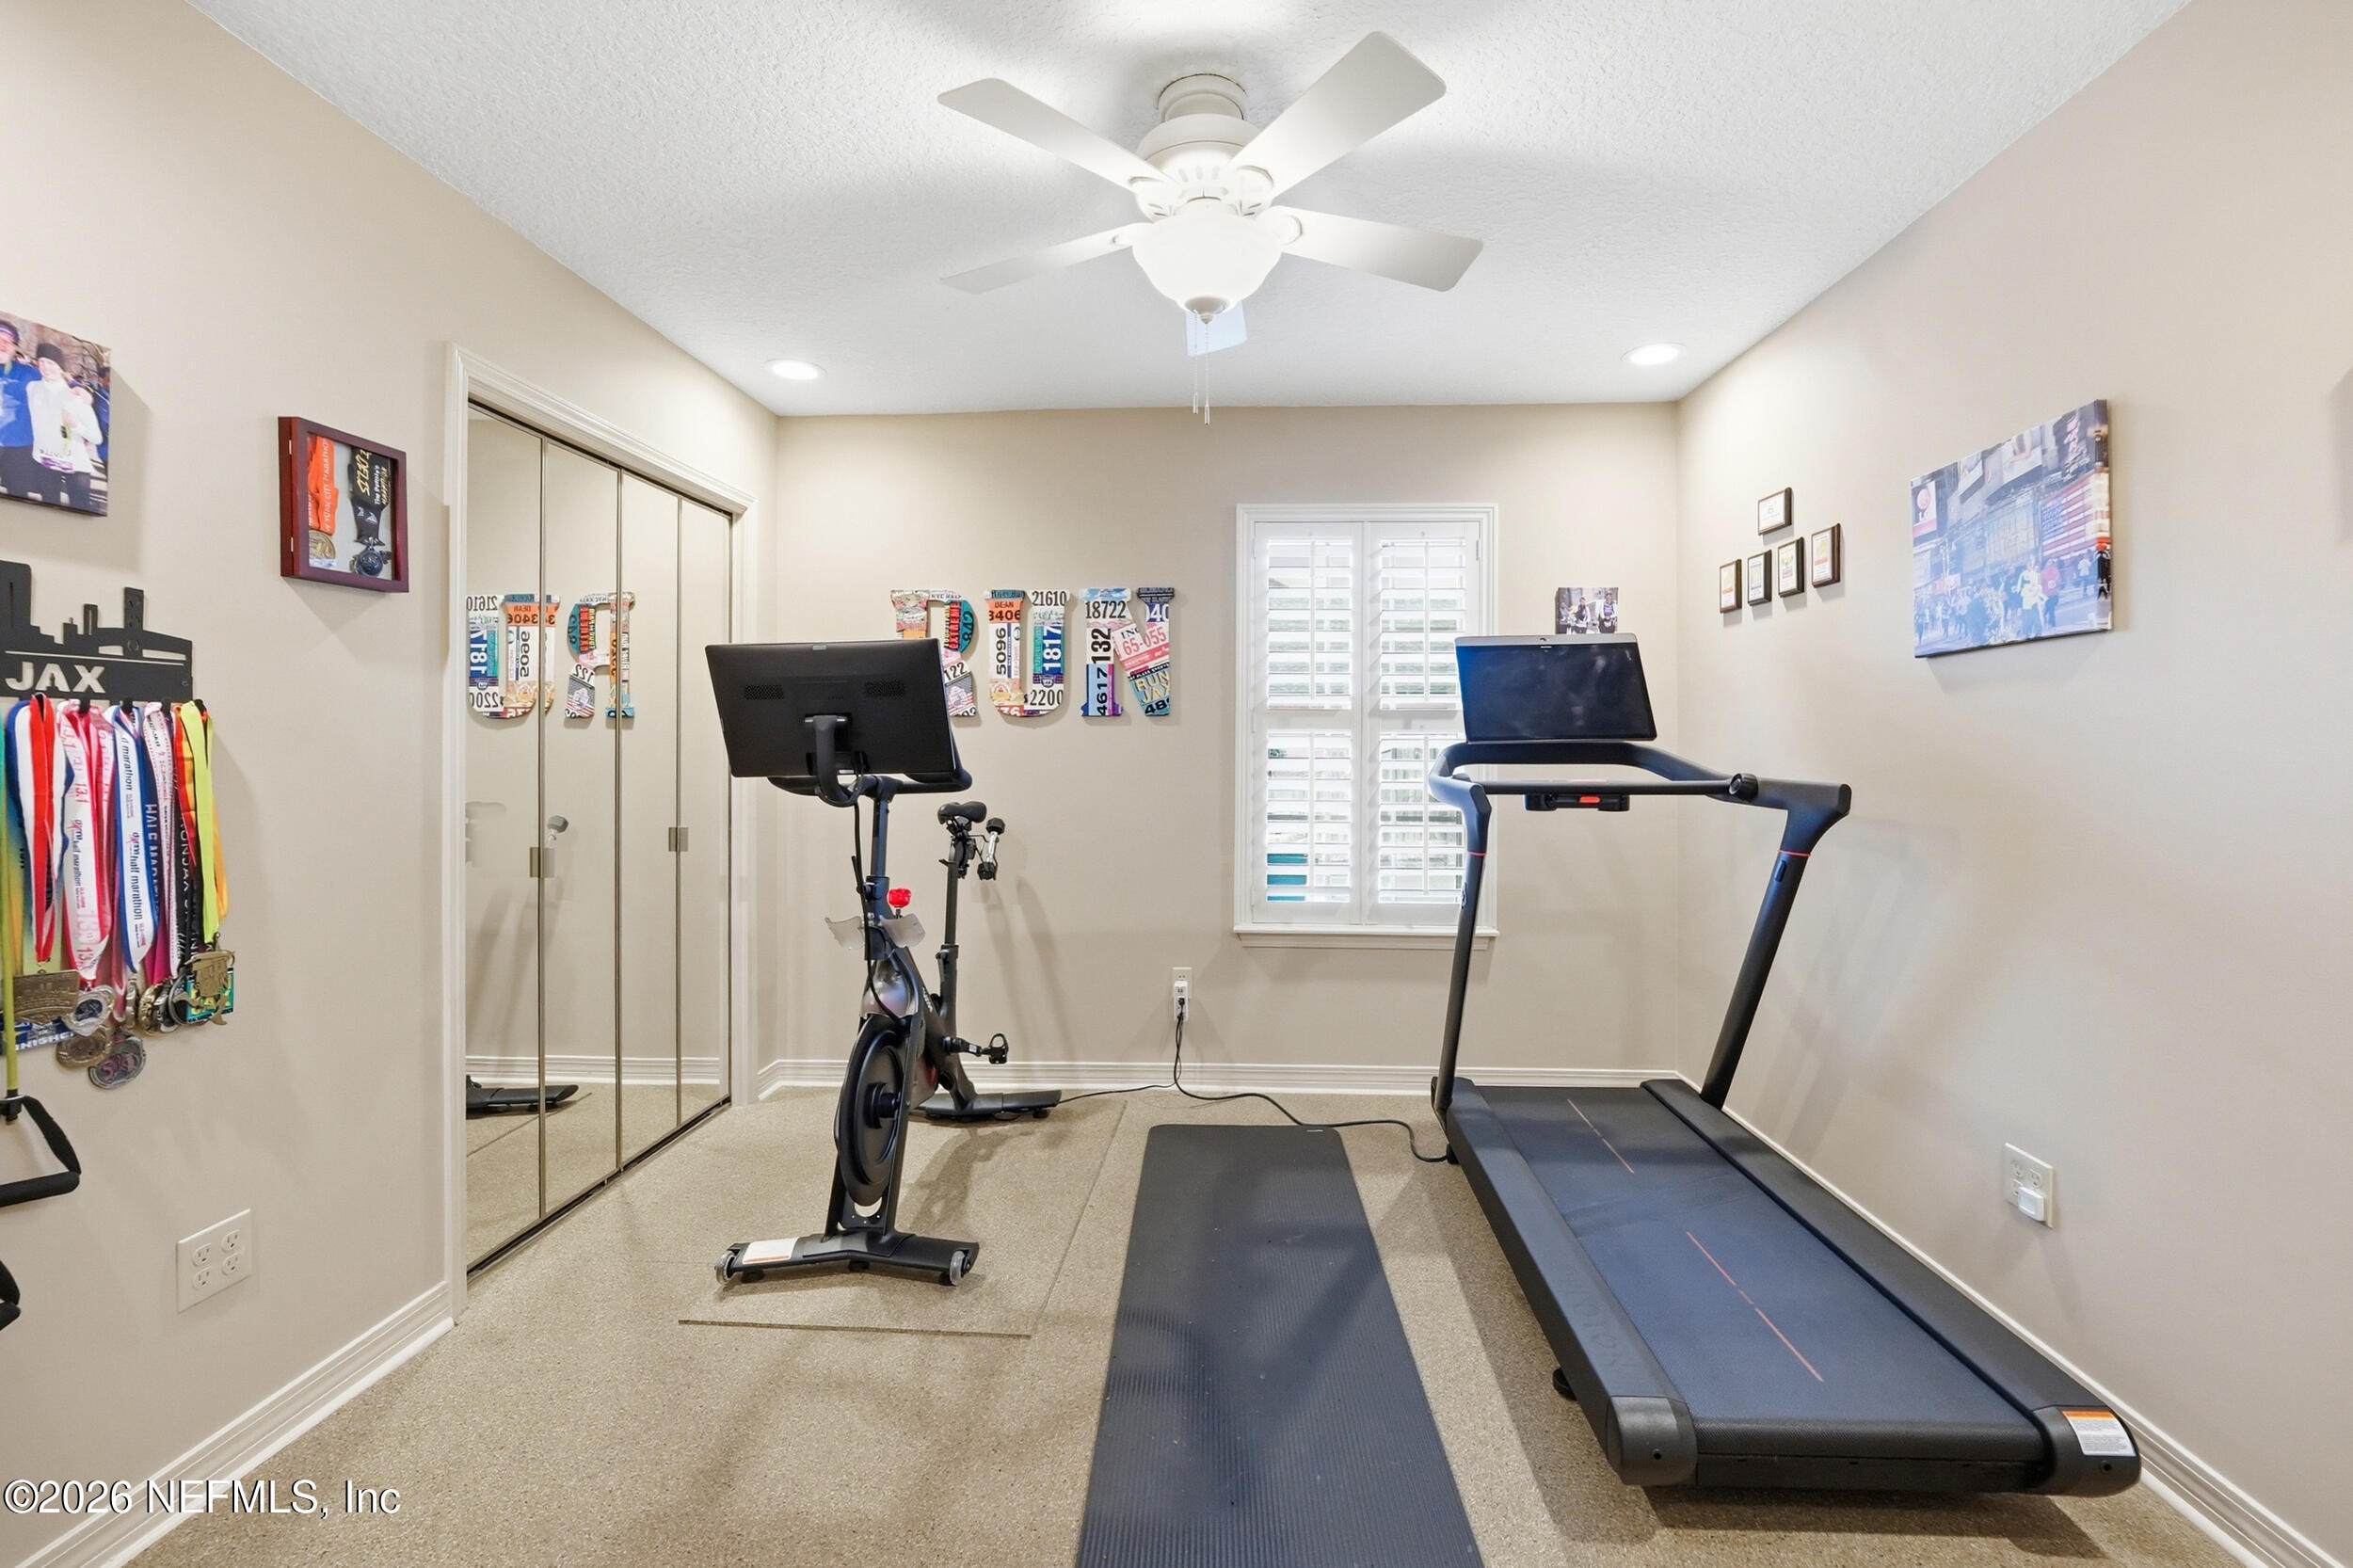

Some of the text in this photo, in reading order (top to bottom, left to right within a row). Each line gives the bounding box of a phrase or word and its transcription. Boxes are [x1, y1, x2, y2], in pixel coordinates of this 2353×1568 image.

[1032, 590, 1066, 606] 21610
[1084, 600, 1127, 619] 18722
[996, 627, 1006, 676] 5096
[1091, 628, 1112, 664] 132
[5, 661, 105, 694] JAX
[1096, 666, 1108, 715] 4617
[122, 745, 133, 791] marathon
[131, 875, 144, 920] marathon
